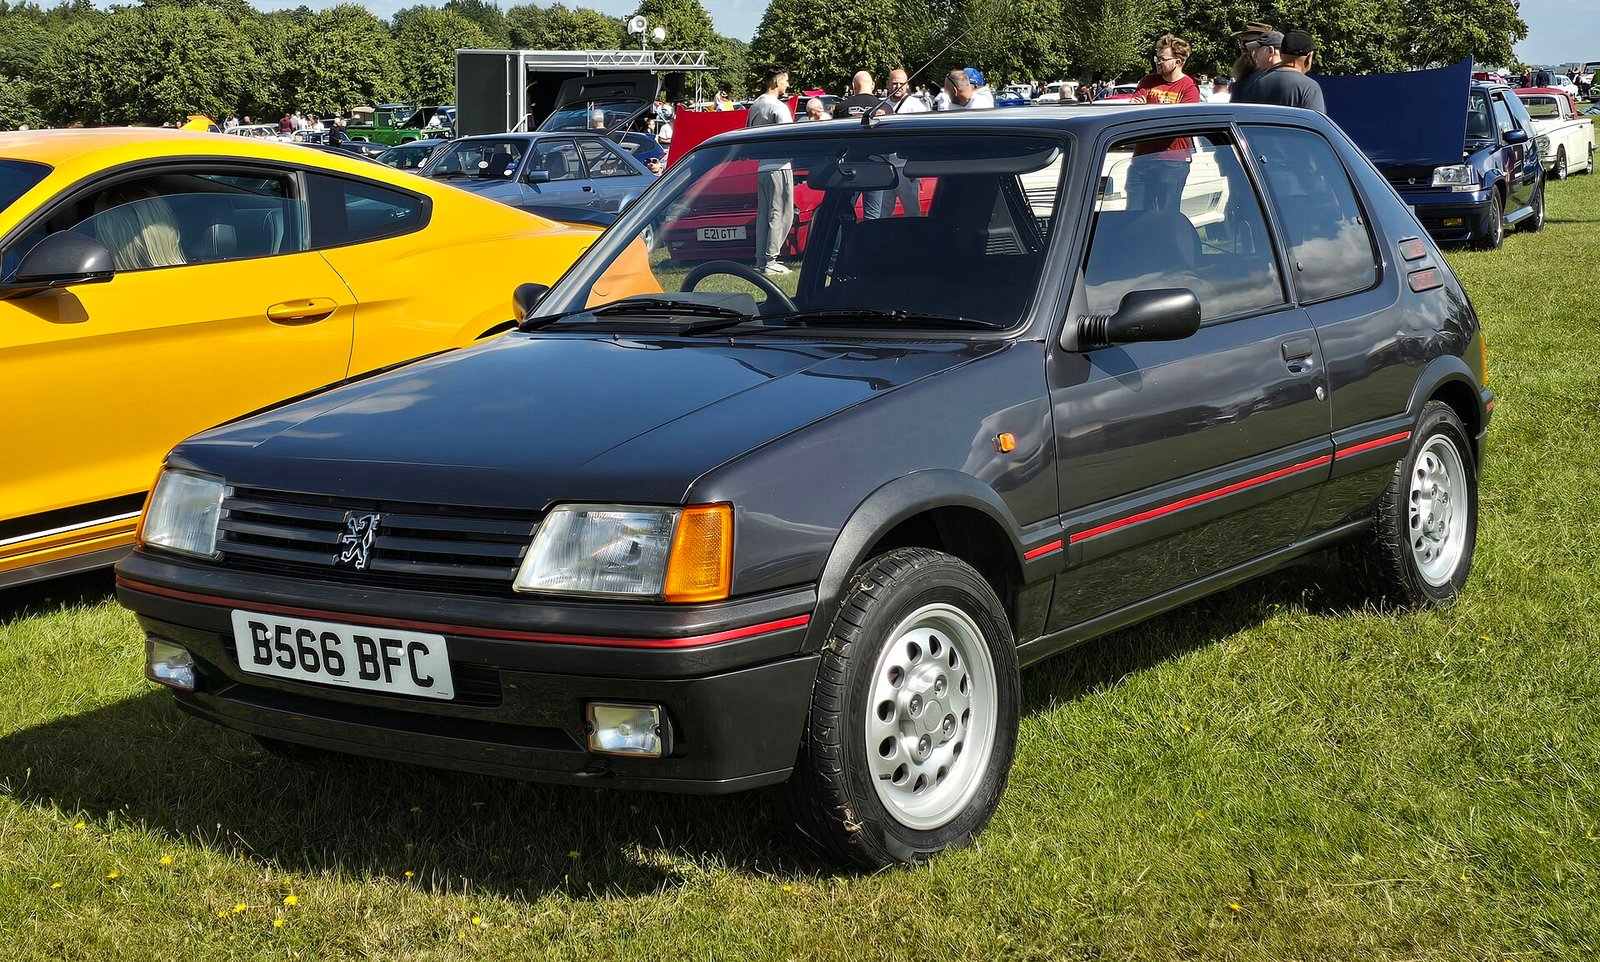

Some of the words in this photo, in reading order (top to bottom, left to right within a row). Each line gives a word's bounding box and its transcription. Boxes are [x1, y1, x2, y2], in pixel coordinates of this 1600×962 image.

[704, 229, 719, 239] E21
[721, 228, 737, 239] GTT
[248, 620, 345, 677] B566
[353, 634, 435, 688] BFC
